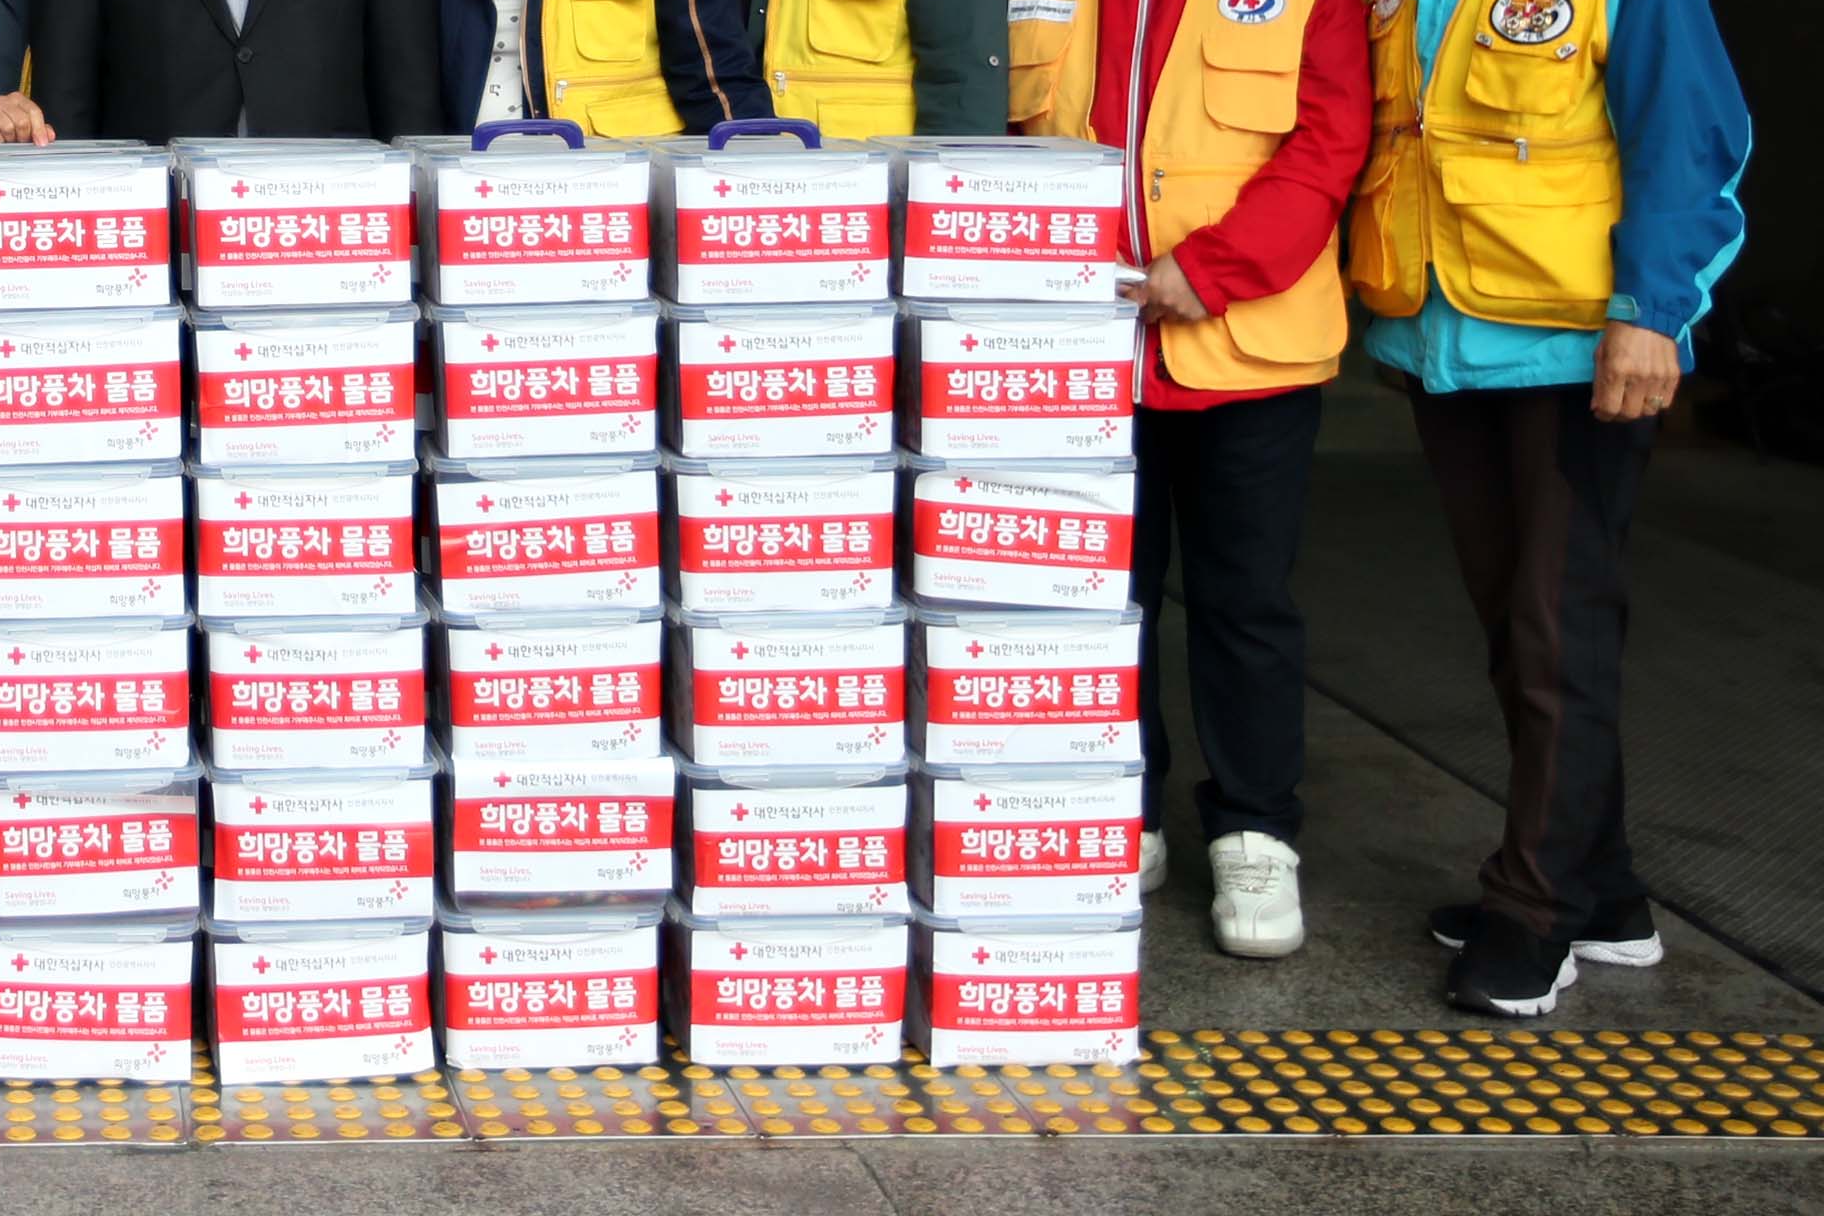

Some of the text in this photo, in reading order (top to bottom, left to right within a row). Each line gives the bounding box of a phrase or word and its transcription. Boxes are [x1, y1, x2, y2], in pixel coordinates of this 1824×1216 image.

[93, 216, 148, 249] 물품
[219, 212, 392, 248] 희망풍차 물품
[464, 211, 632, 248] 희망풍차 물품
[702, 211, 871, 247] 희망풍차 물품
[932, 209, 1100, 245] 희망풍차 물품
[103, 370, 158, 403] 물품
[223, 372, 395, 411] 희망풍차 물품
[471, 363, 640, 401] 희망풍차 물품
[707, 365, 877, 402] 희망풍차 물품
[948, 368, 1118, 401] 희망풍차 물품
[108, 527, 162, 559] 물품
[222, 525, 393, 559] 희망풍차 물품
[465, 521, 637, 562] 희망풍차 물품
[703, 521, 873, 556] 희망풍차 물품
[938, 508, 1111, 552] 희망풍차 물품
[267, 648, 338, 663] 대한적십자사
[113, 680, 167, 712] 물품
[232, 679, 402, 713] 희망풍차 물품
[474, 672, 642, 710] 희망풍차 물품
[719, 675, 888, 709] 희망풍차 물품
[954, 674, 1122, 708] 희망풍차 물품
[516, 771, 586, 786] 대한적십자사
[480, 802, 649, 835] 희망풍차 물품
[1, 819, 174, 859] 희망풍차 물품
[237, 830, 409, 864] 희망풍차 물품
[719, 836, 889, 871] 희망풍차 물품
[963, 826, 1127, 861] 희망풍차 물품
[995, 950, 1063, 965] 대한적십자사
[115, 992, 168, 1024] 물품
[241, 984, 413, 1025] 희망풍차 물품
[468, 977, 638, 1014] 희망풍차 물품
[718, 976, 885, 1009] 희망풍차 물품
[961, 981, 1125, 1014] 희망풍차 물품
